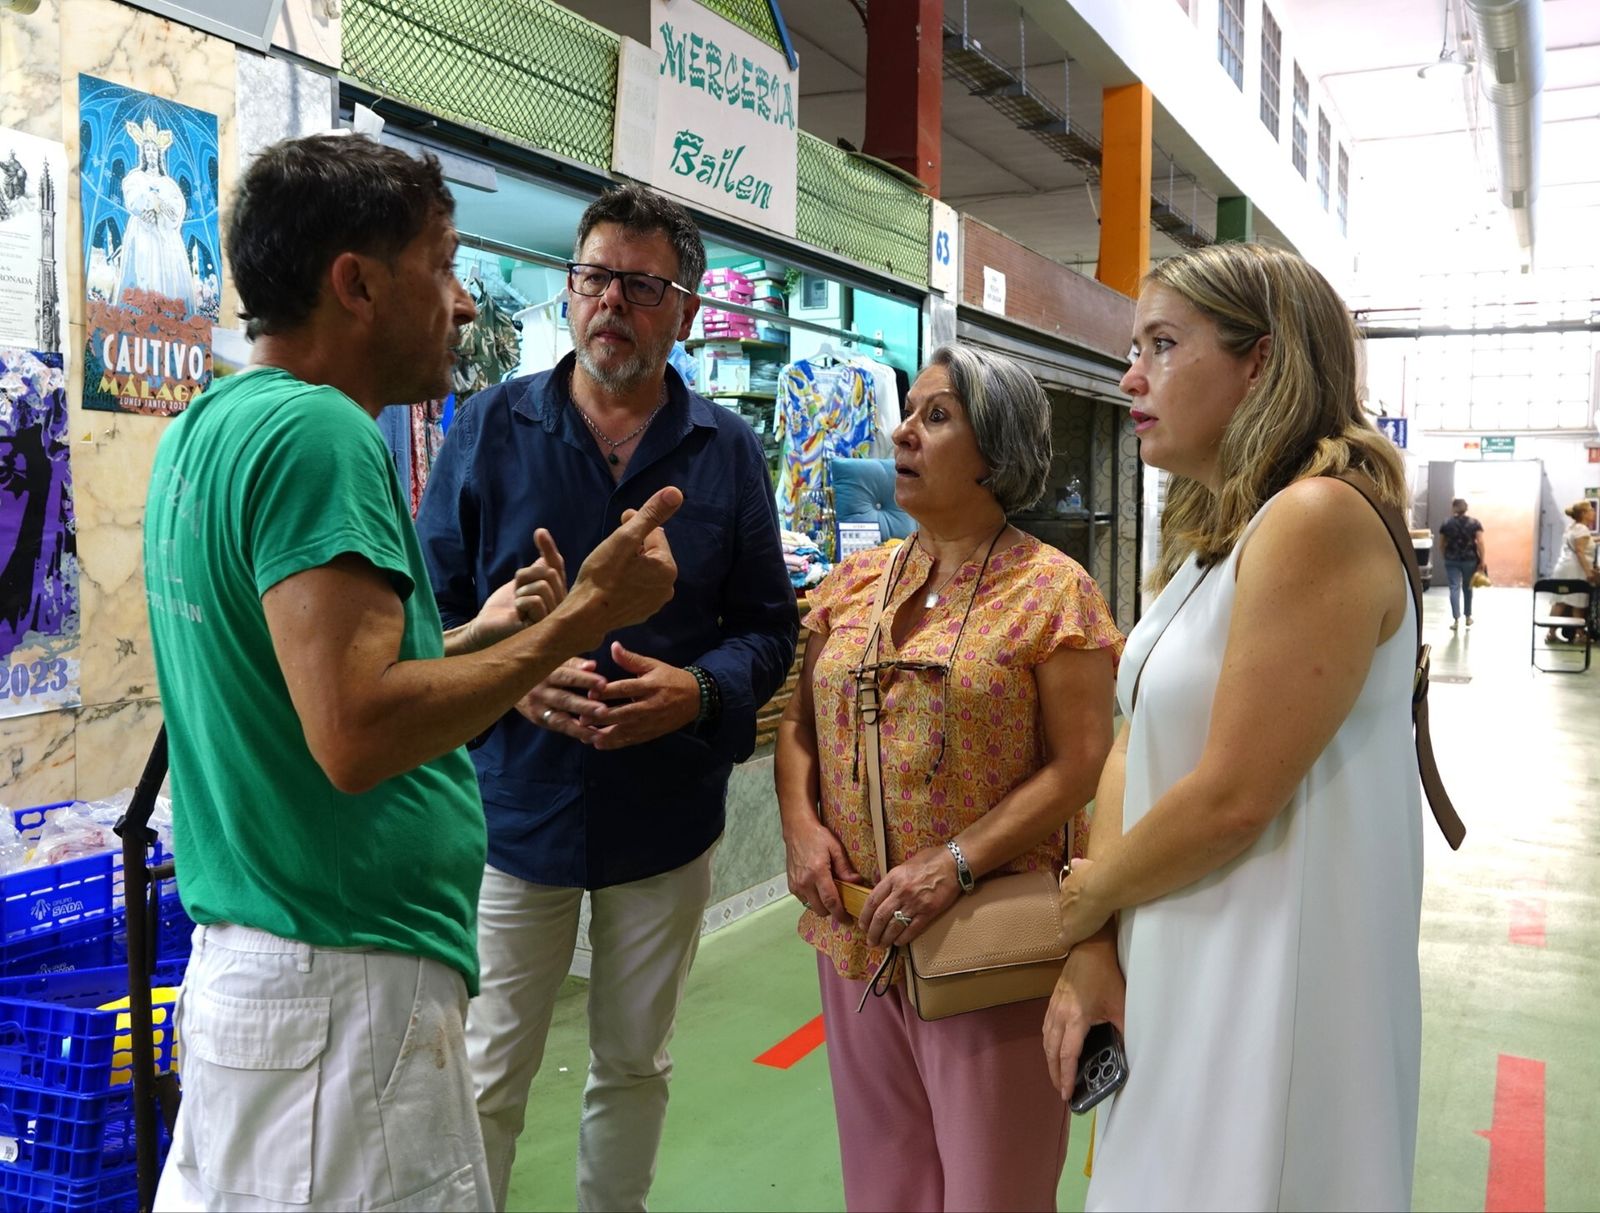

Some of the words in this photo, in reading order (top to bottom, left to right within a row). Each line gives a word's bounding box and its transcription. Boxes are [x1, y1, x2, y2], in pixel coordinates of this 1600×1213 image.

[669, 130, 773, 210] Bailen
[936, 230, 950, 266] 63
[103, 333, 204, 380] CAUTIVO
[0, 657, 68, 699] 2023
[52, 900, 84, 917] SADA
